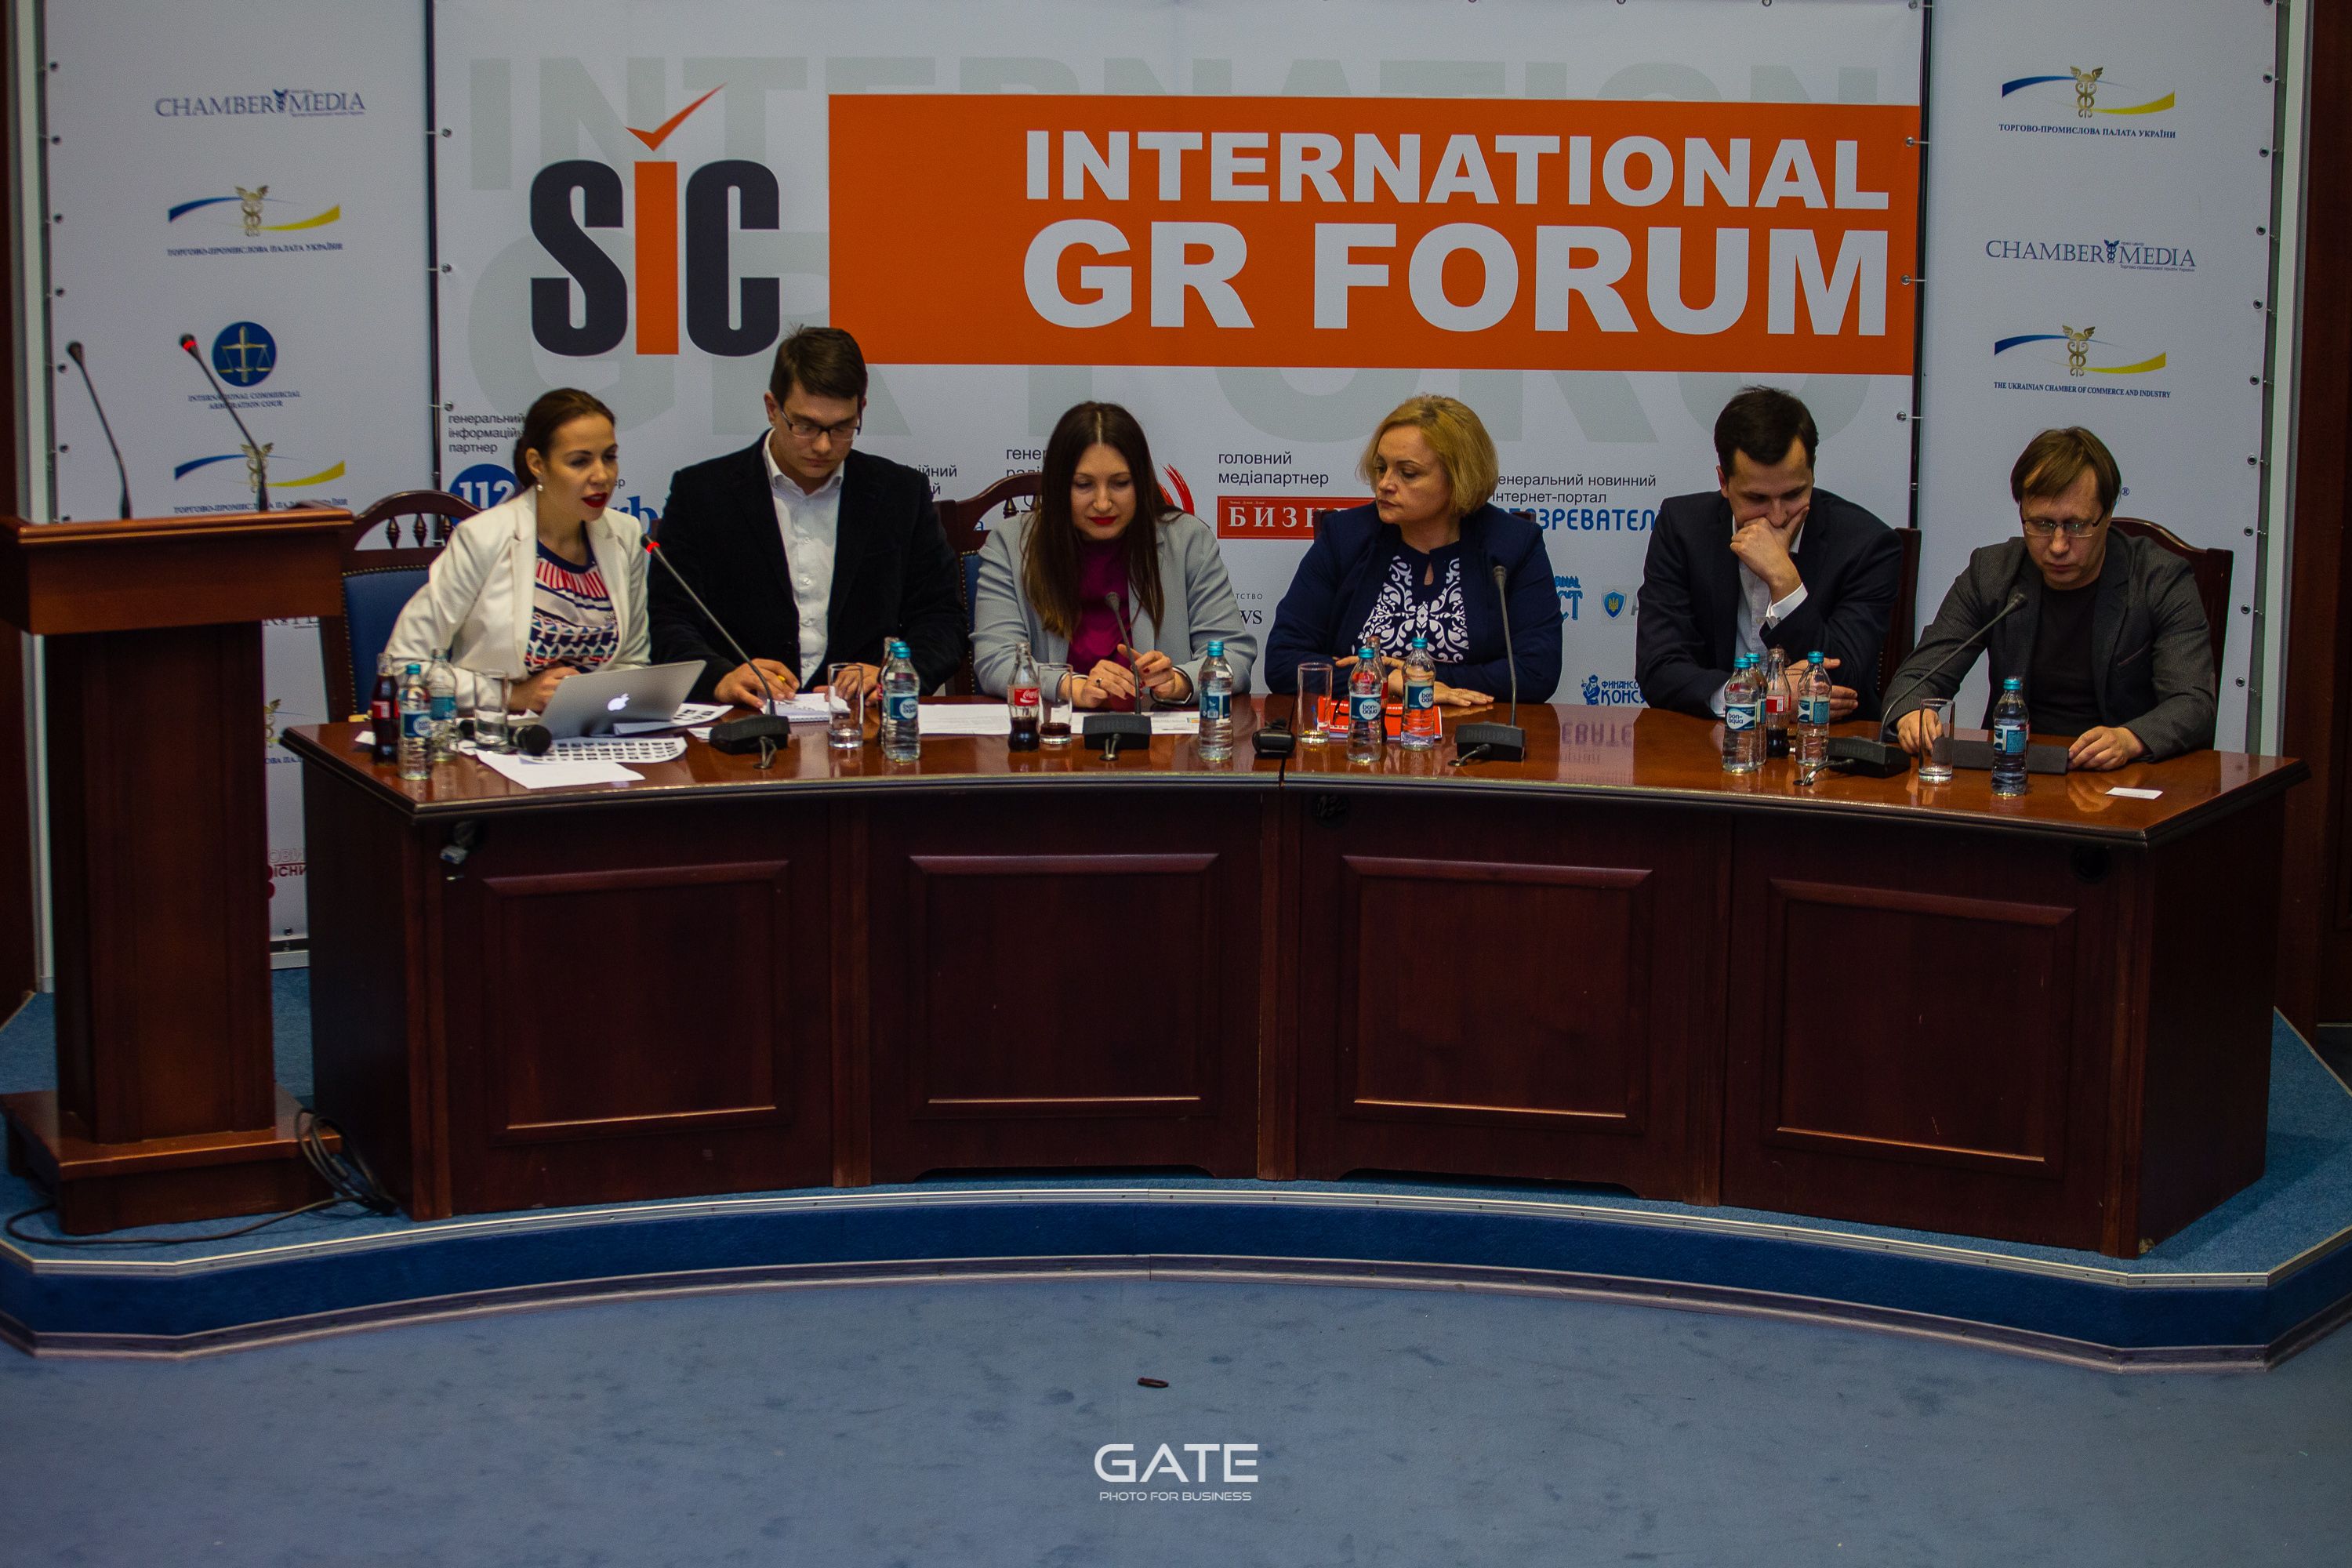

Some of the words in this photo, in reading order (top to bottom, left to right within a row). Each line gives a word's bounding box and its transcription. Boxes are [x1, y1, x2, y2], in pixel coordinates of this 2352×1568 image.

[155, 94, 278, 118] CHAMBER
[289, 92, 366, 114] MEDIA
[1999, 124, 2100, 136] ТОРГОВО-ПРОМИСЛОВА
[2103, 128, 2136, 138] ПАЛАТА
[2139, 129, 2176, 139] УКРАЇНИ
[1026, 129, 1889, 210] INTERNATIONAL
[530, 158, 781, 358] SIC
[1985, 240, 2105, 263] CHAMBER
[2118, 246, 2196, 267] MEDIA
[1024, 219, 1255, 329] GR
[1312, 222, 1889, 337] FORUM
[1994, 381, 2007, 390] THE
[2008, 382, 2045, 391] UKRAINIAN
[2045, 383, 2078, 394] CHAMBER
[2087, 386, 2125, 396] COMMERCE
[2140, 390, 2172, 398] INDUSTRY
[448, 444, 498, 455] партнер
[1218, 452, 1292, 464] головний
[1218, 470, 1329, 487] медіапартнер
[1498, 474, 1584, 488] енеральний
[1588, 474, 1657, 487] новинний
[459, 480, 515, 510] 112
[1228, 506, 1348, 528] БИЗН
[1501, 507, 1661, 532] ЗРЕВАТЕЛ
